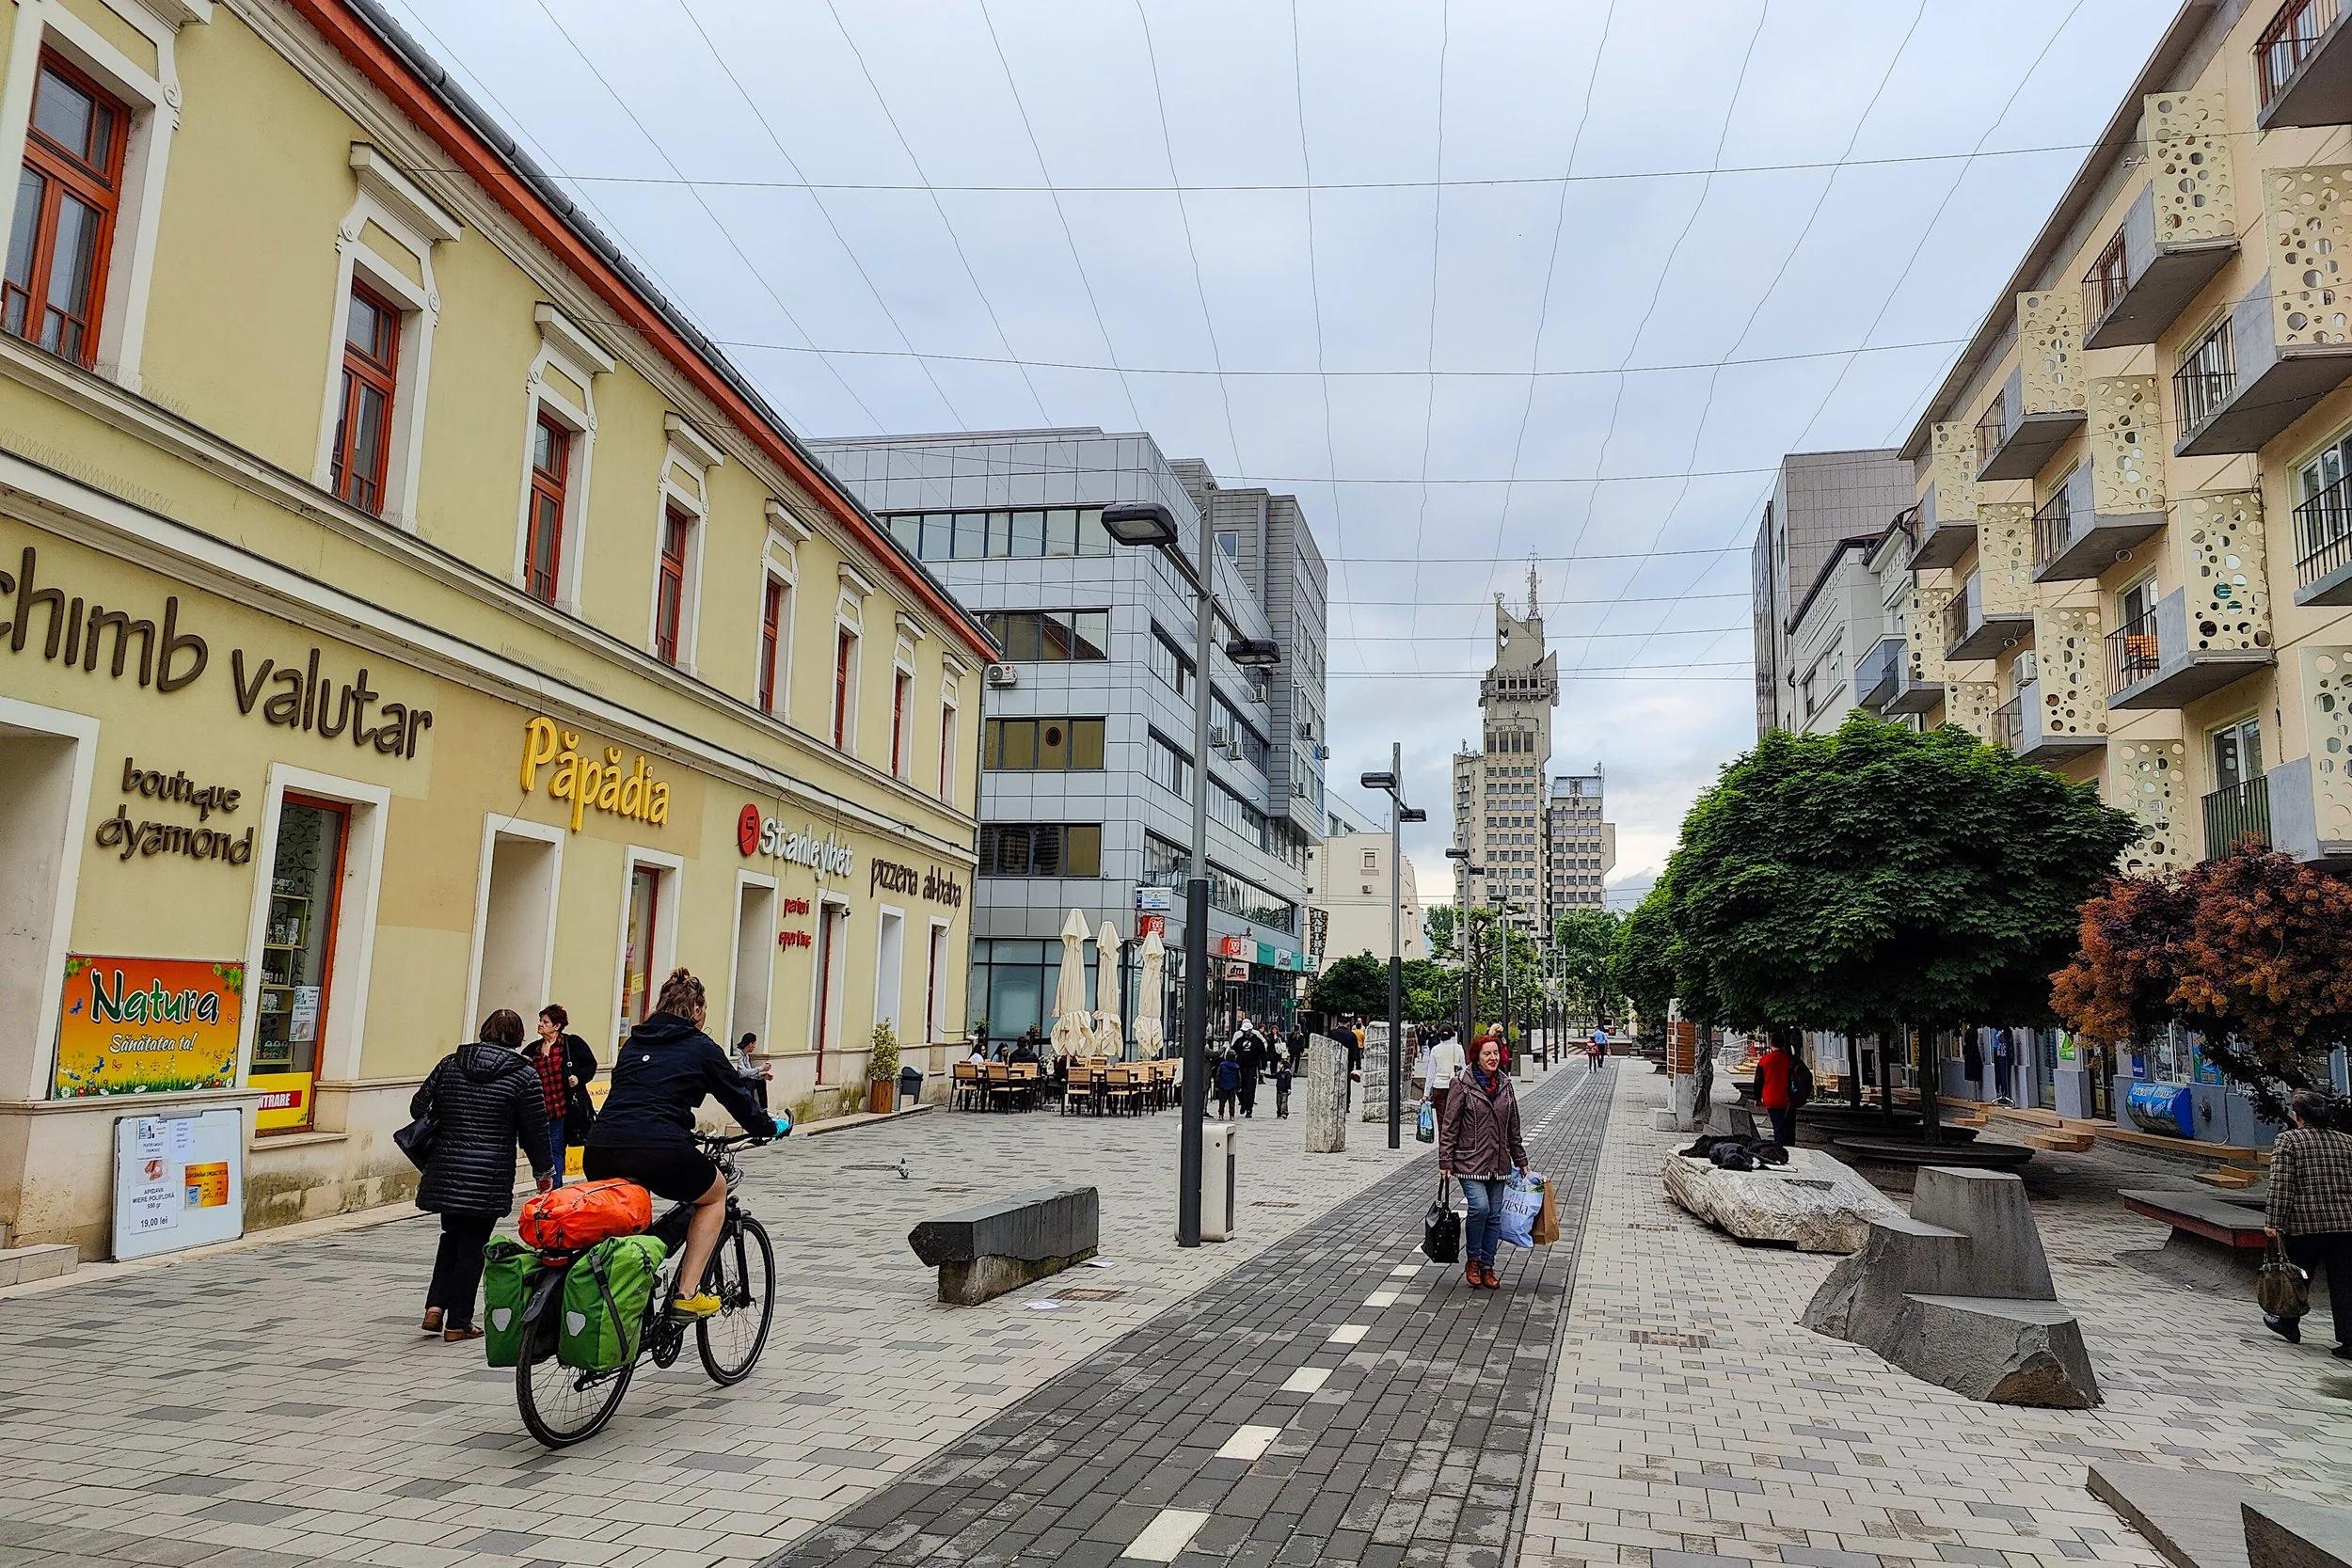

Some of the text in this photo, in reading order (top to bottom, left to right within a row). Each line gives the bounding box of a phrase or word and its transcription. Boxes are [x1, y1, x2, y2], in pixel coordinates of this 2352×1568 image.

[231, 647, 433, 760] valutar
[121, 756, 241, 821] boutique
[520, 716, 671, 832] Păpădia
[96, 804, 254, 863] dyamond
[758, 816, 853, 881] Stanleybet
[870, 857, 918, 899] pizzeria
[90, 968, 219, 1024] Natura
[1231, 965, 1244, 974] dm
[109, 1032, 199, 1053] Sănătatea ta!
[258, 1093, 291, 1108] NTRARE
[140, 1215, 168, 1228] 19,00 lei
